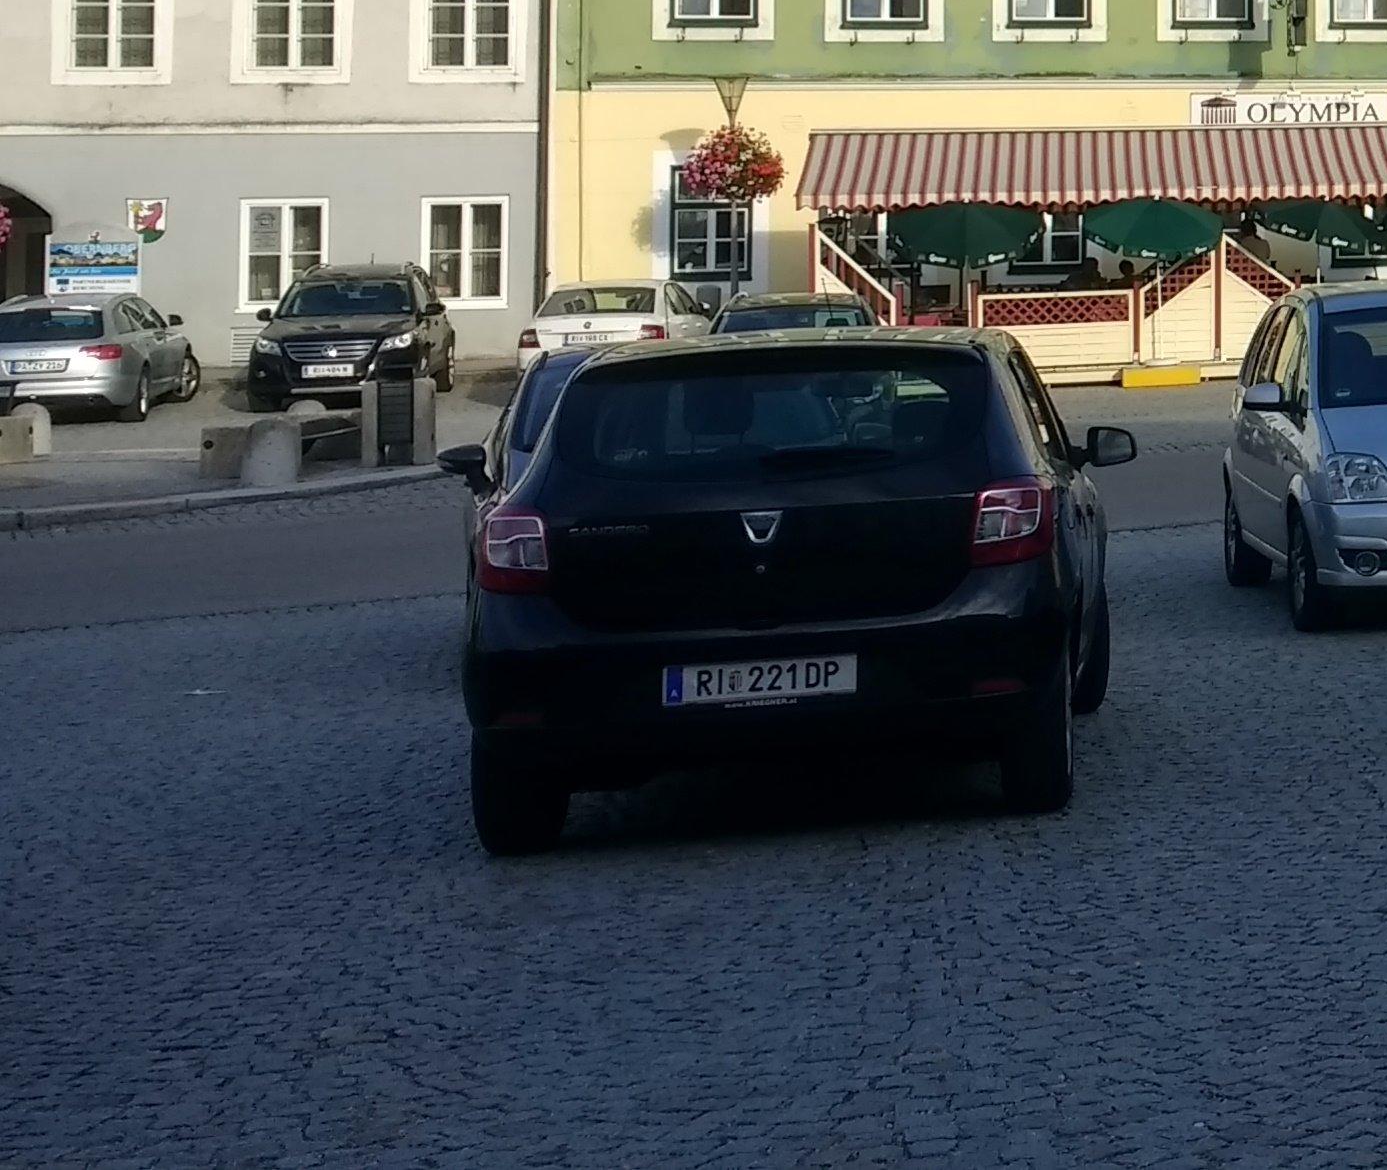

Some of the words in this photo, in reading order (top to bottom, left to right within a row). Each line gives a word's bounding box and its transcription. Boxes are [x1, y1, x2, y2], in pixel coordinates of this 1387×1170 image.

[1247, 102, 1380, 124] OLYMPIA
[697, 668, 723, 697] RI
[748, 663, 798, 693] 221
[805, 661, 840, 689] DP
